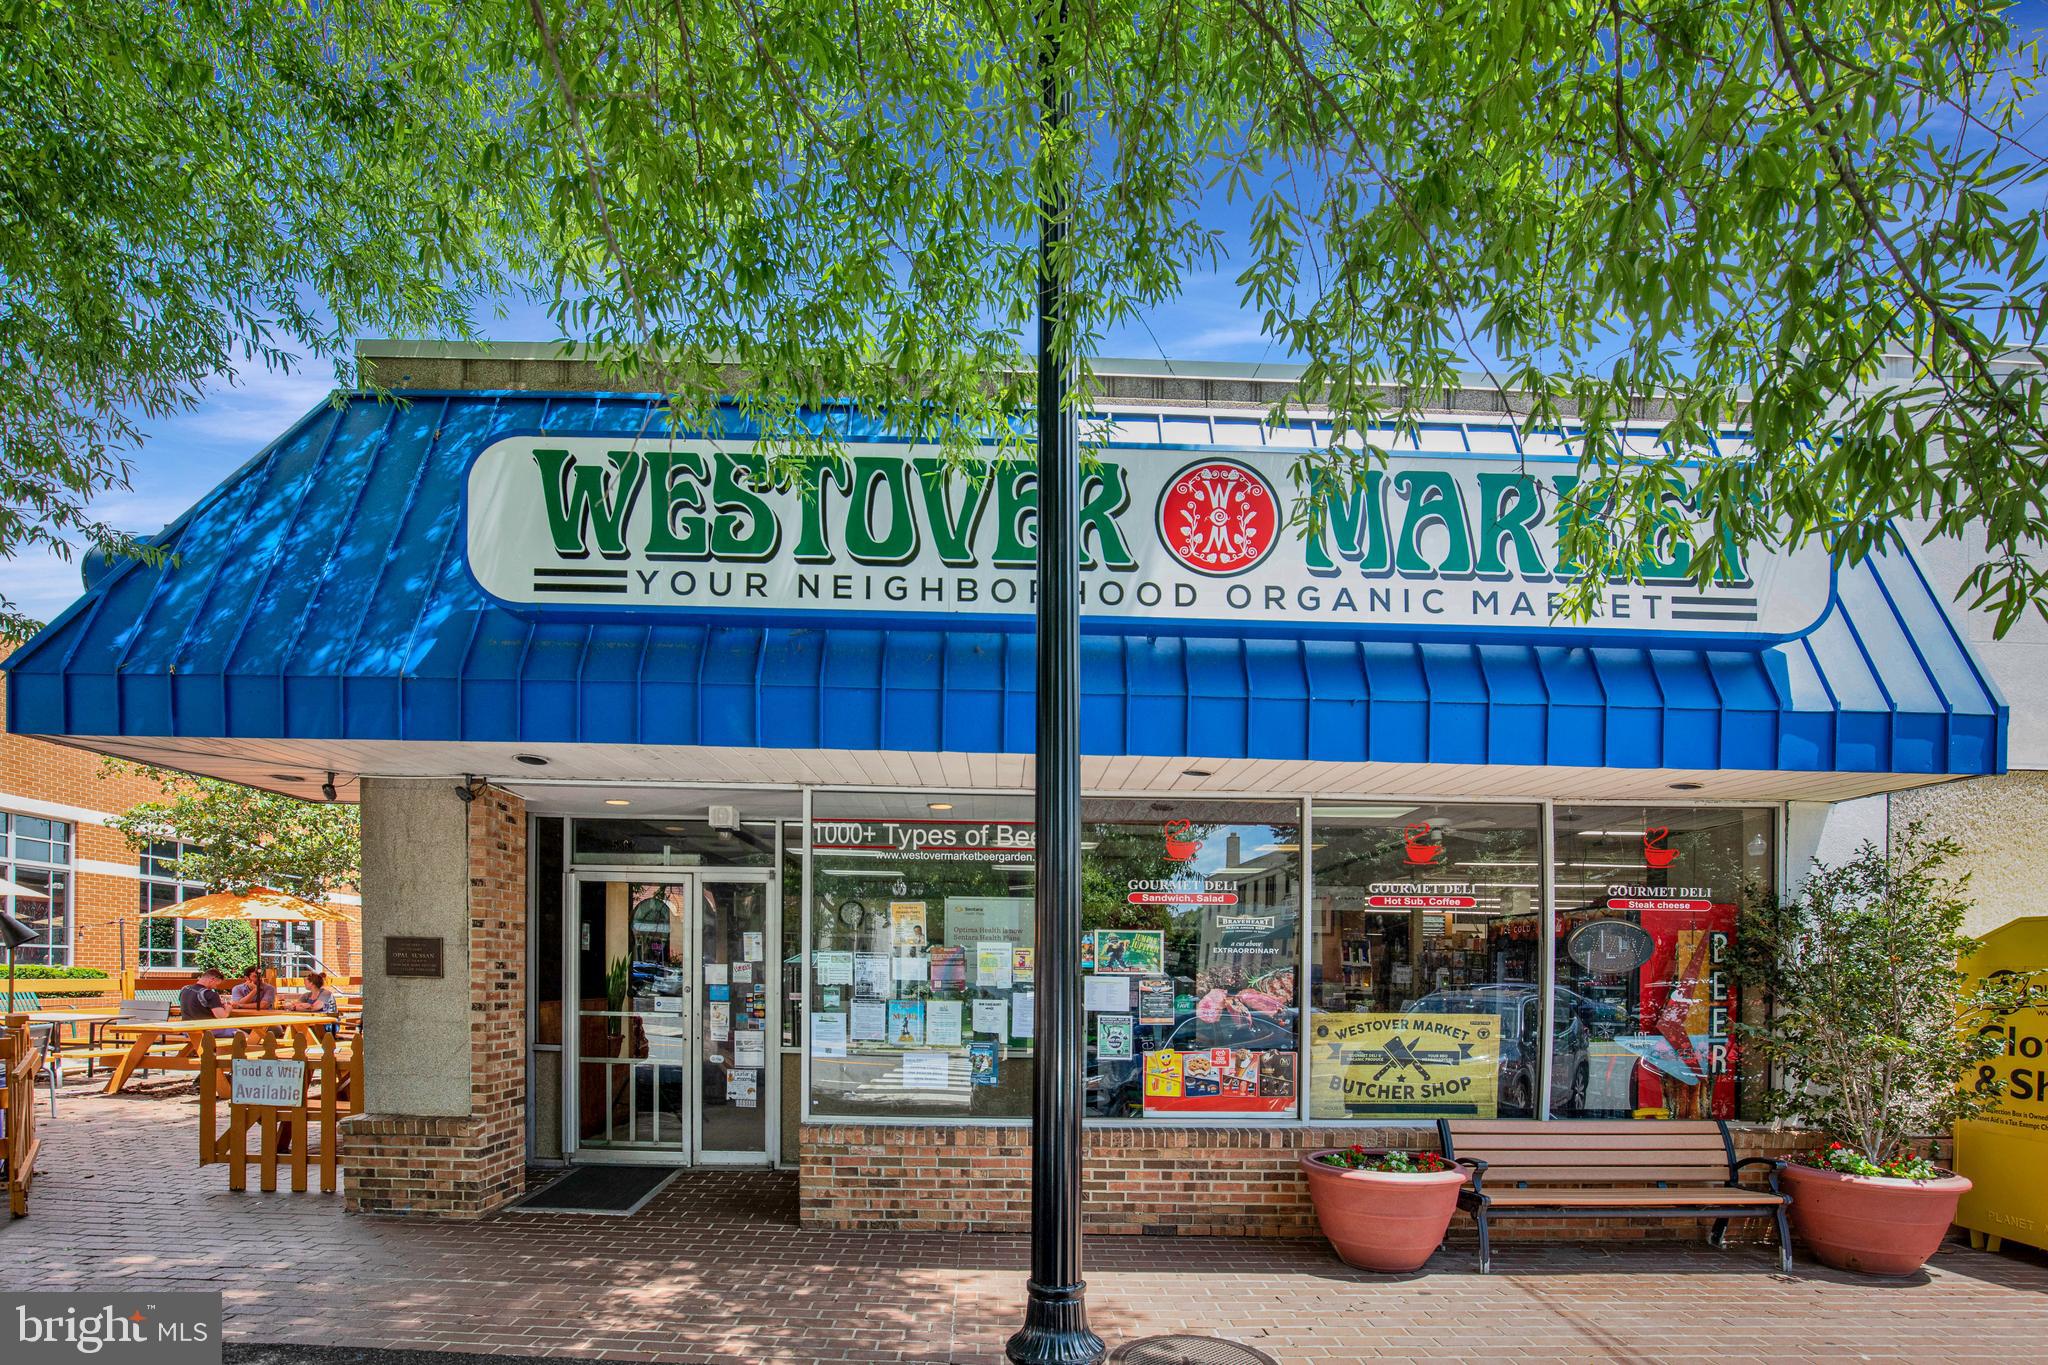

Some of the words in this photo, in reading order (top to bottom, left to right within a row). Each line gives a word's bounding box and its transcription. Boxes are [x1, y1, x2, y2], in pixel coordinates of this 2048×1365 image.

[532, 449, 1139, 572] WESTOVER
[636, 569, 769, 599] YOUR
[1226, 584, 1445, 615] ORGANIC
[813, 822, 876, 845] 1000+
[882, 823, 957, 850] Types
[965, 824, 990, 846] of
[1128, 879, 1201, 891] GOURMET
[1205, 880, 1238, 891] DELI
[1368, 883, 1439, 894] GOURMET
[1444, 883, 1476, 894] DELI
[1607, 885, 1676, 897] GOURMET
[1680, 887, 1712, 898] DELI
[1196, 894, 1224, 903] Salad
[1384, 897, 1402, 905] Hot
[1403, 897, 1426, 906] Sub,
[1428, 897, 1461, 906] Coffee
[1628, 900, 1655, 909] Steak
[1657, 901, 1691, 909] cheese
[1711, 933, 1729, 1074] BEER
[1334, 1018, 1409, 1040] WESTOVER
[1412, 1019, 1470, 1041] MARKET
[1979, 1025, 2048, 1058] Clo
[235, 1065, 262, 1077] Food
[266, 1065, 273, 1077] &
[1975, 1065, 2002, 1097] &
[236, 1083, 300, 1101] Available
[1329, 1075, 1415, 1100] BUTCHER
[1421, 1076, 1472, 1098] SHOP
